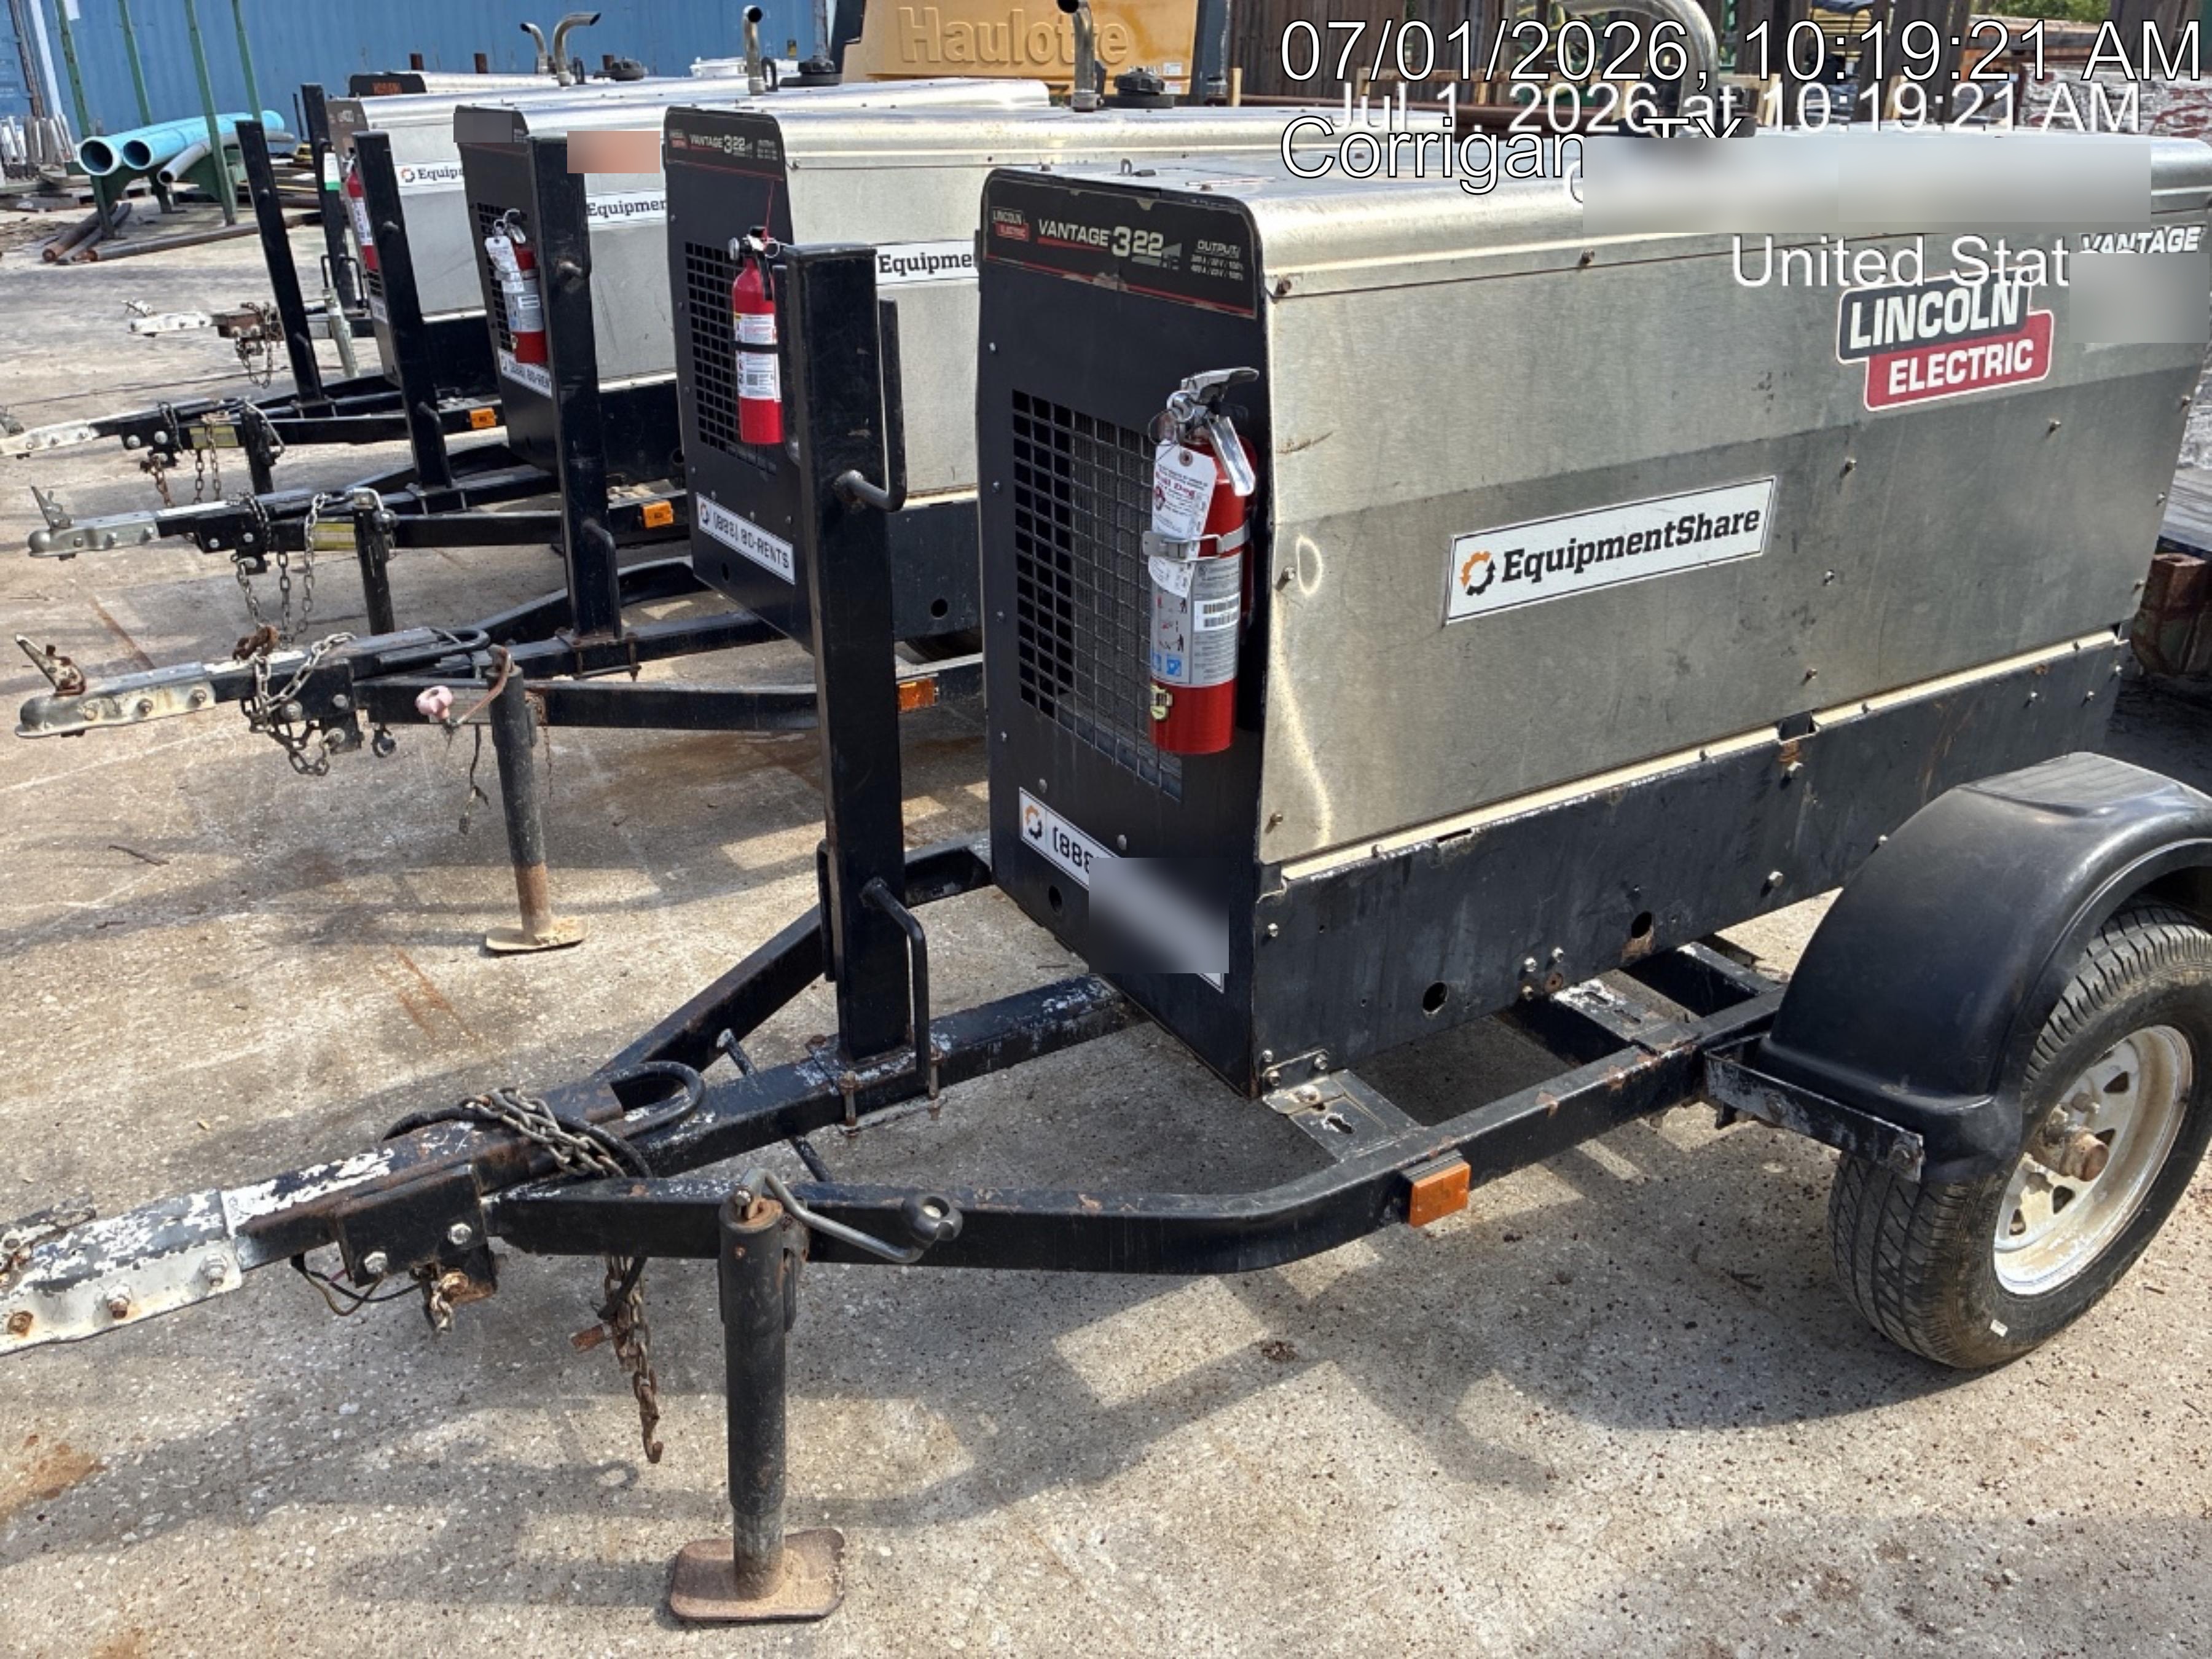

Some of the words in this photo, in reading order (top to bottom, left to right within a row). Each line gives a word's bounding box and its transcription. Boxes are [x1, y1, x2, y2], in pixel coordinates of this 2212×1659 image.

[896, 7, 1129, 66] Haulote
[1038, 218, 1112, 247] VANTAGE
[1112, 226, 1164, 257] 322
[1849, 283, 2020, 350] LINCOLN
[1888, 339, 2035, 396] ELECTRIC
[1501, 509, 1760, 584] EquipmentShare
[1053, 825, 1099, 874] (888
